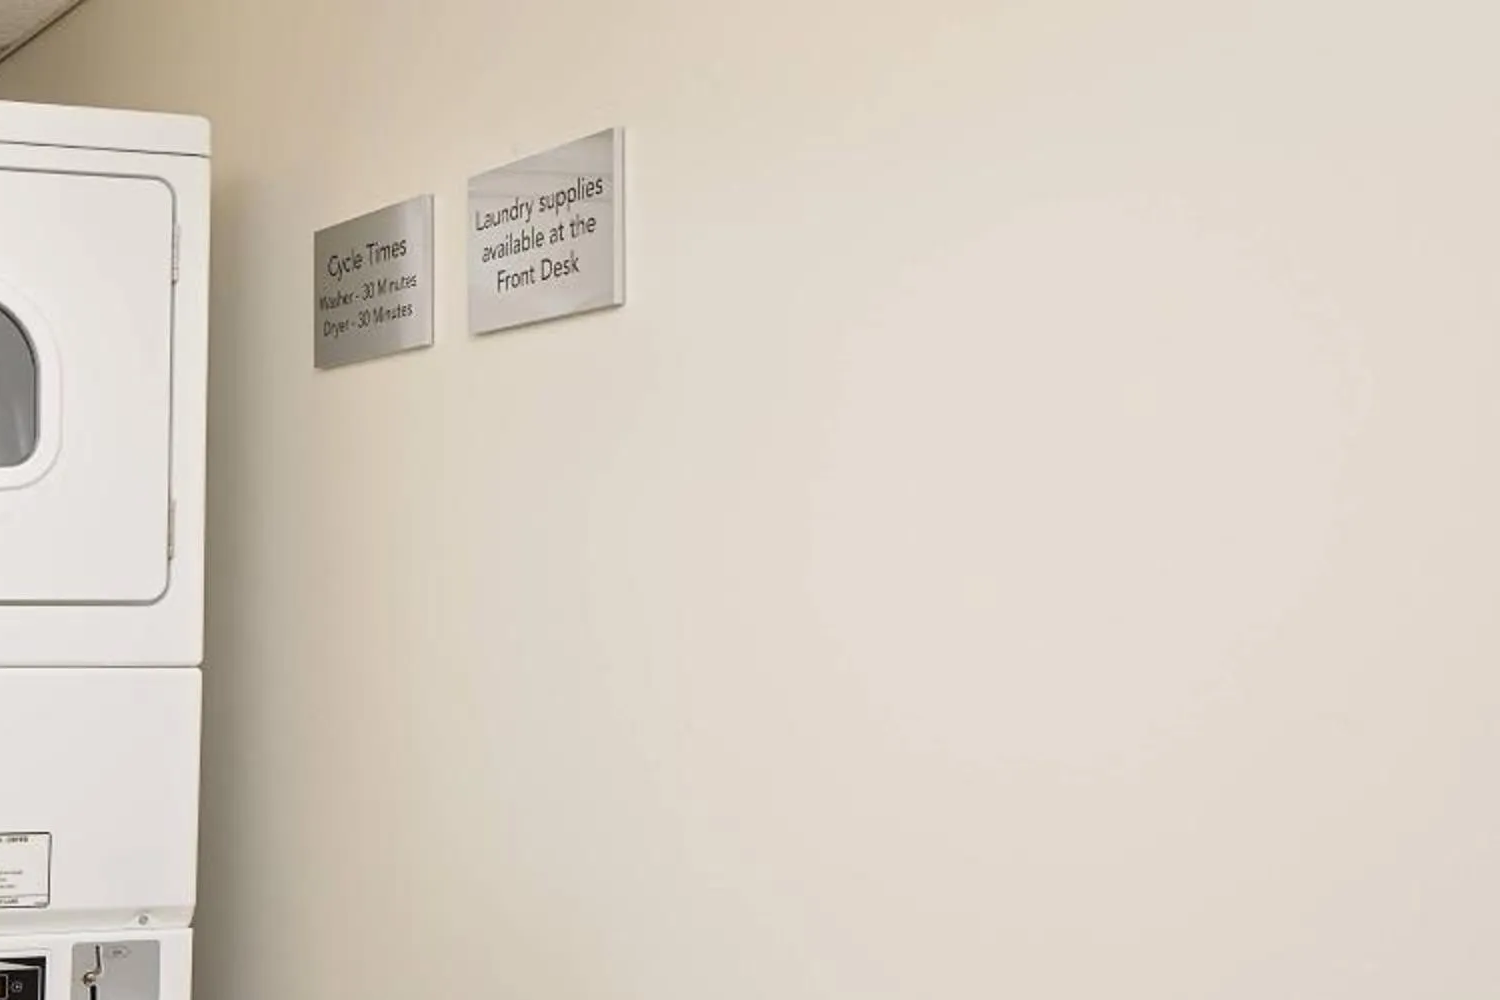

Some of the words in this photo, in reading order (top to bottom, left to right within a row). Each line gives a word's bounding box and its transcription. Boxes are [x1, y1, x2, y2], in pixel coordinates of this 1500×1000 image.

[475, 196, 534, 231] Laundry
[539, 176, 603, 217] supplies
[482, 225, 545, 263] available
[549, 222, 564, 244] at
[569, 213, 597, 239] the
[327, 248, 363, 282] Cycle
[366, 239, 407, 265] Times
[497, 265, 535, 293] Front
[541, 250, 580, 281] Desk
[362, 282, 375, 301] 30
[377, 274, 417, 295] Minutes
[323, 319, 349, 339] Dryer
[358, 309, 370, 328] 30
[373, 303, 413, 323] Minutes
